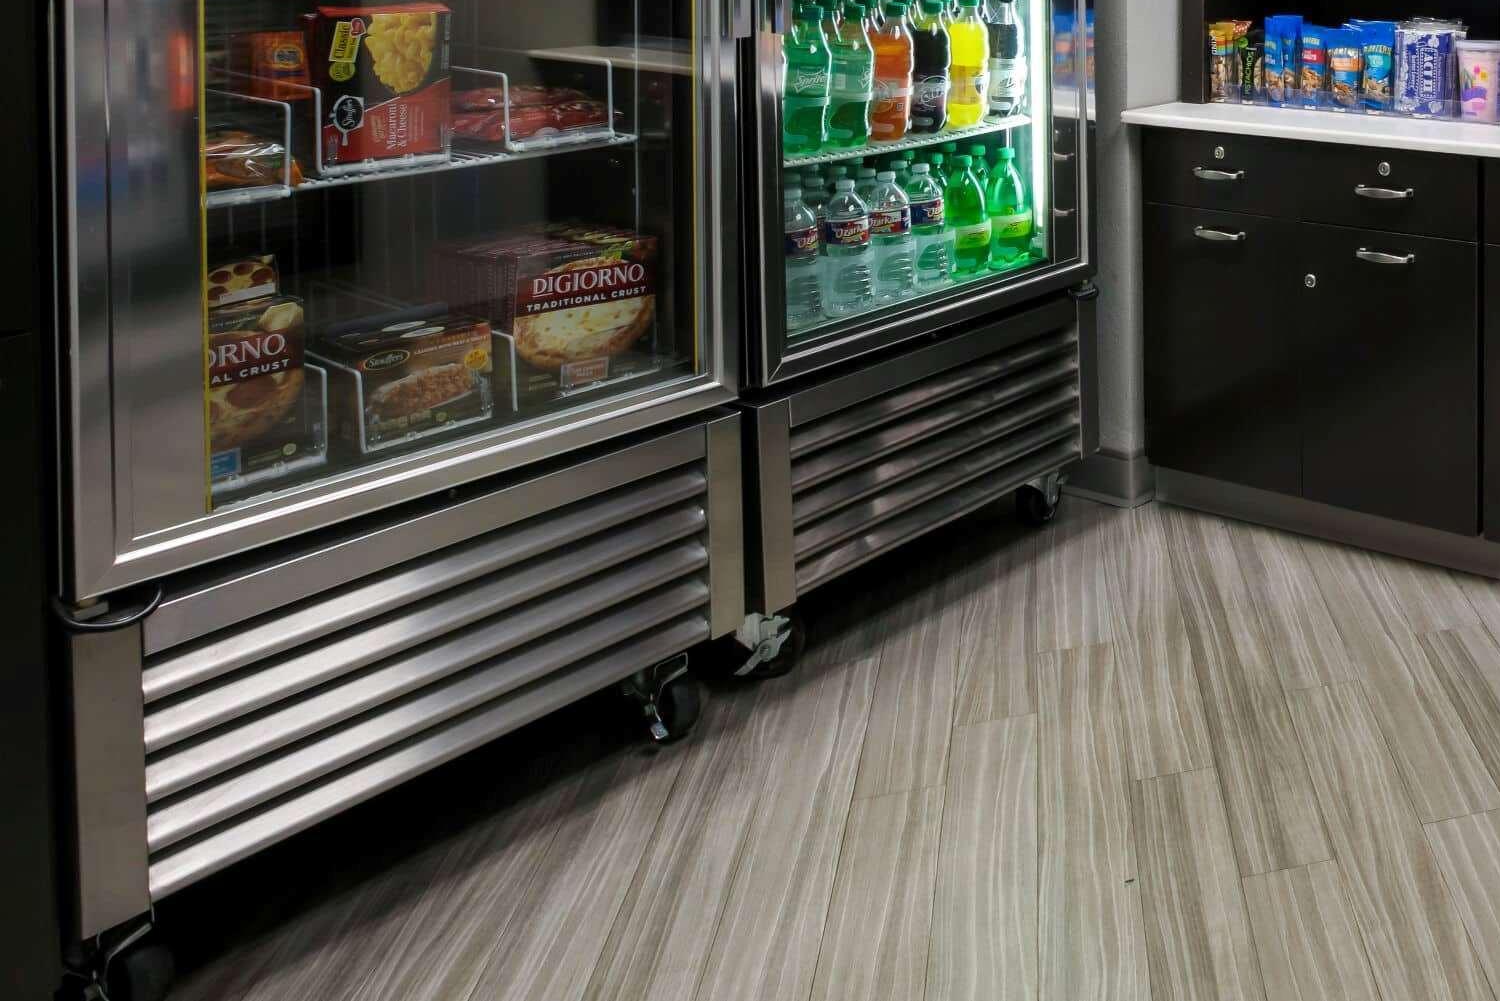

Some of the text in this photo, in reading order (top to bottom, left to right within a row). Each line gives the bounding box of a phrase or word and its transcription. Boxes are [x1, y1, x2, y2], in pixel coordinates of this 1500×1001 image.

[1423, 52, 1433, 93] ACT II
[386, 102, 397, 151] Macaroni
[398, 103, 409, 138] Cheese
[532, 263, 646, 298] DIGIORNO
[526, 285, 647, 312] TRADITIONAL CRUST
[239, 357, 291, 381] CRUST
